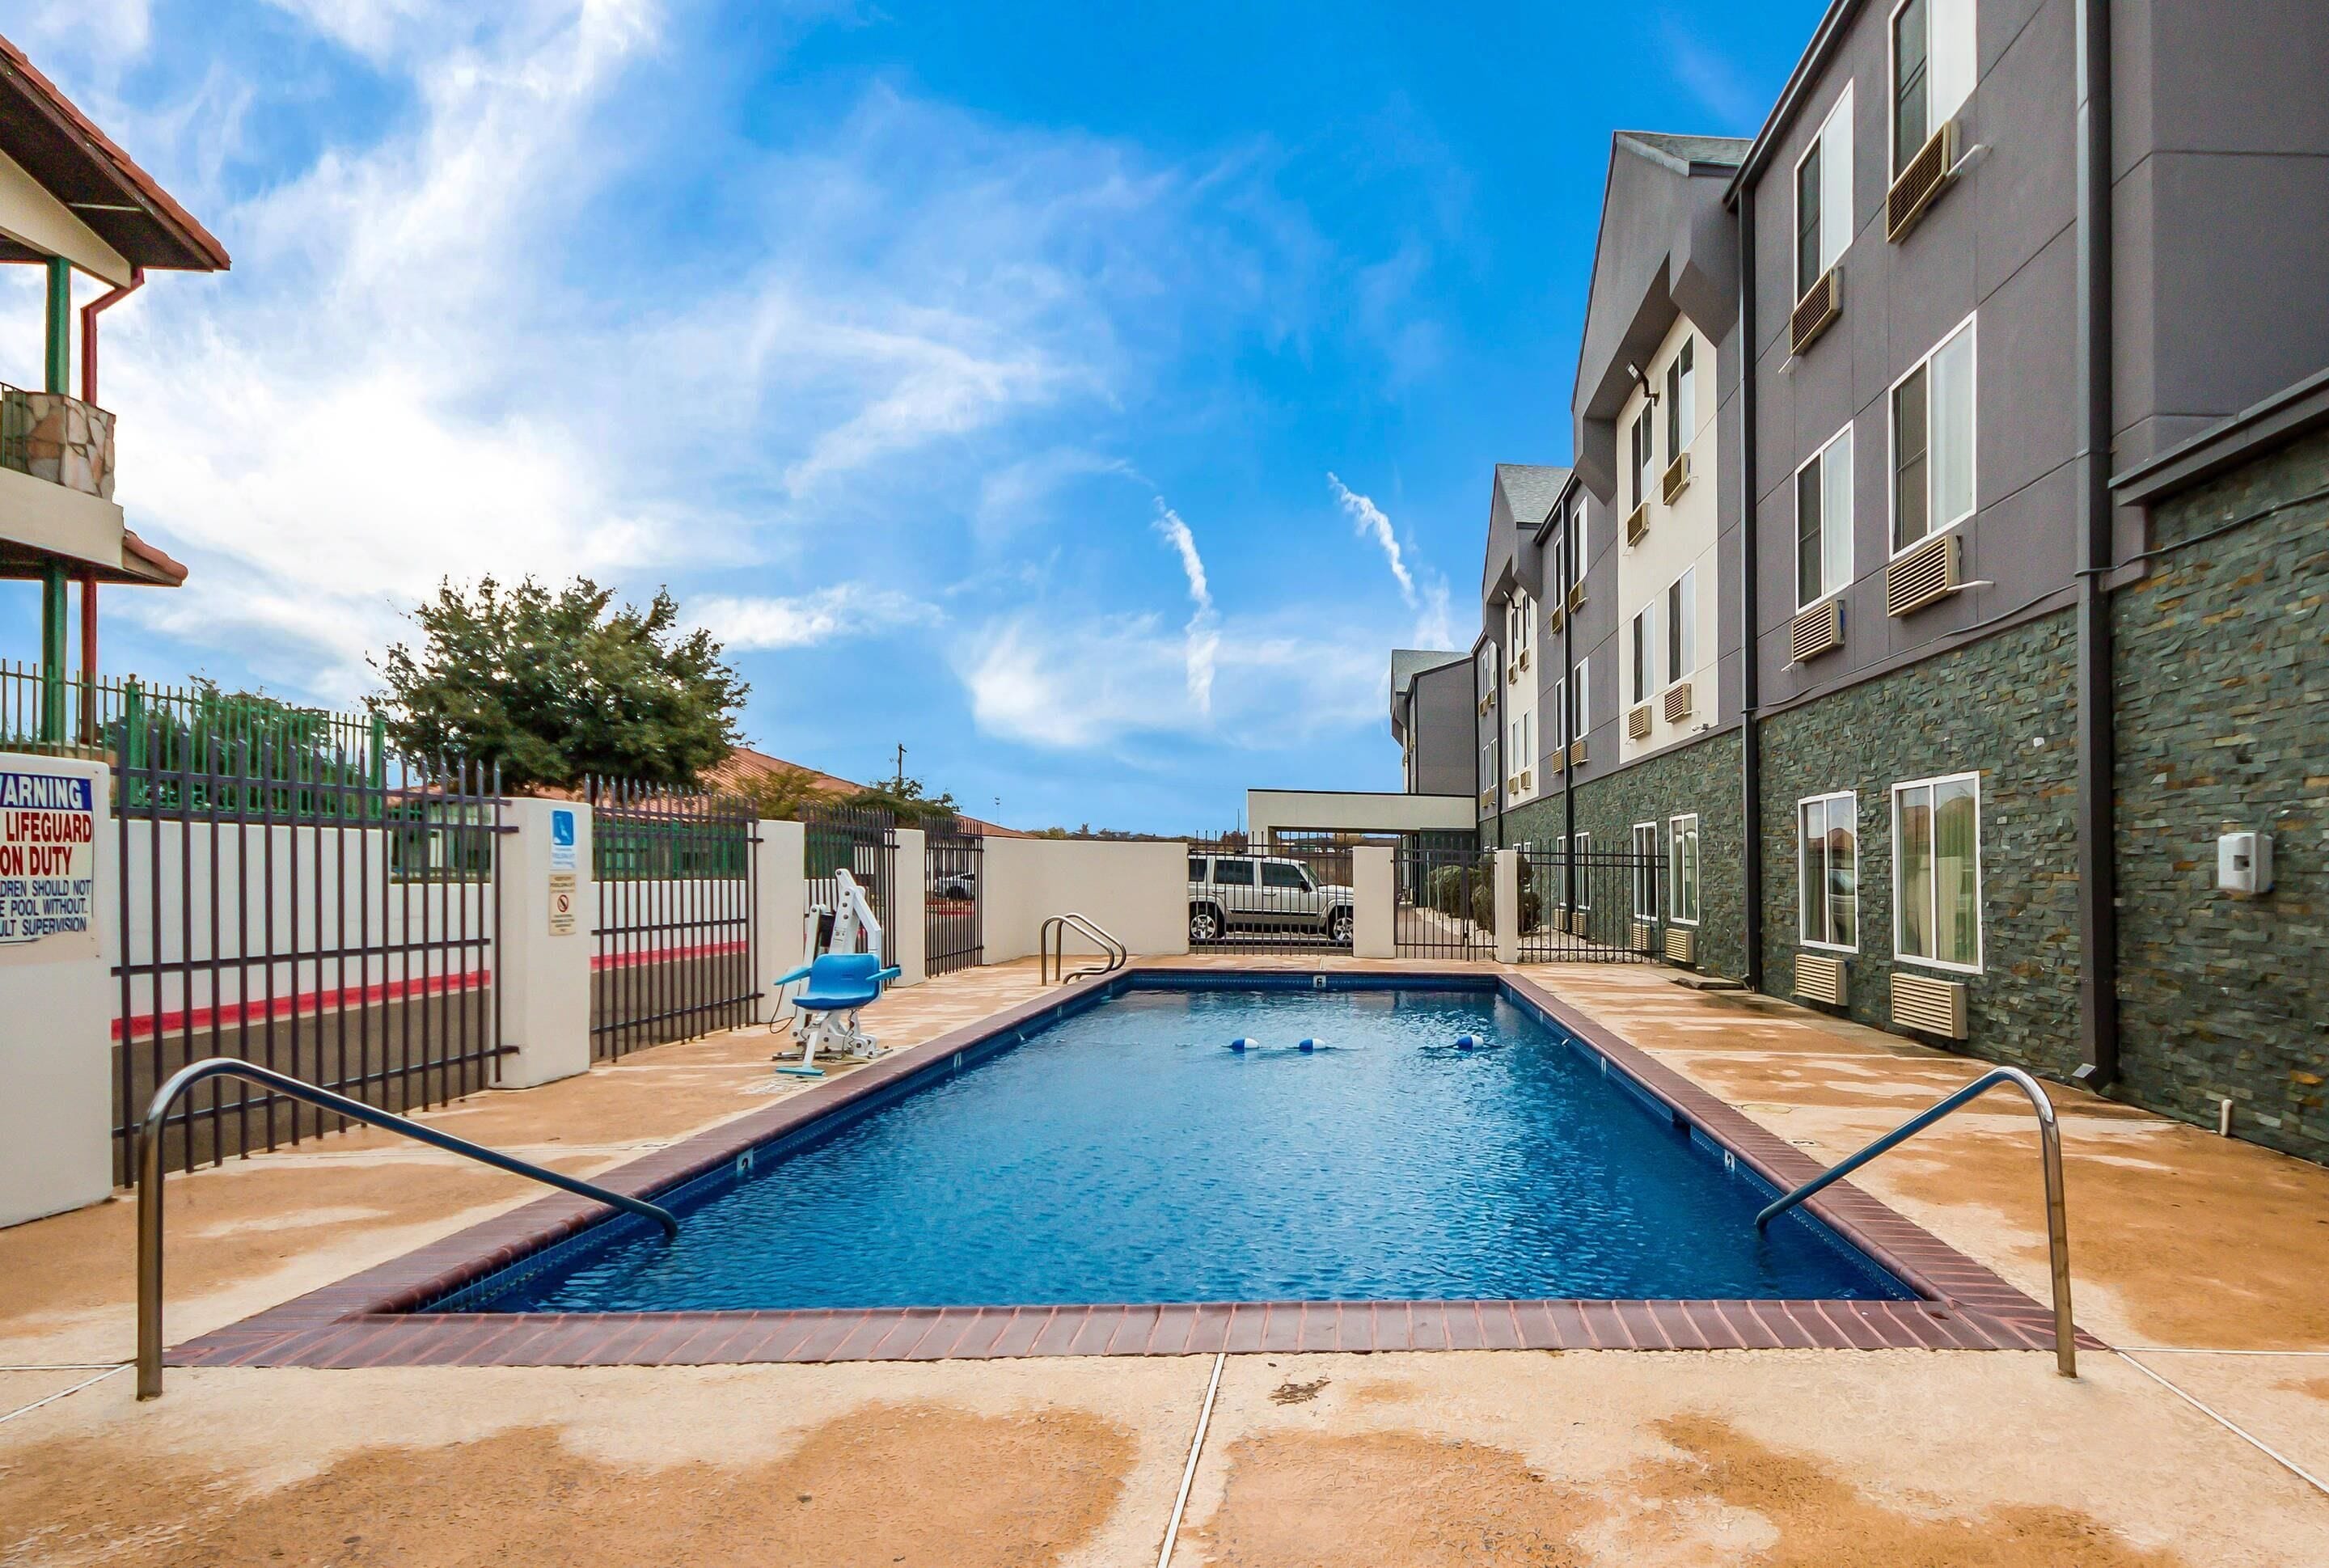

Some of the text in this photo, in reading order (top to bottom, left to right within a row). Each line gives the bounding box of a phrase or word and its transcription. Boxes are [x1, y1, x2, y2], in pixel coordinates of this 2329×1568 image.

[6, 811, 92, 843] LIFEGUARD
[0, 845, 73, 877] ON DUTY
[32, 879, 69, 897] SHOULD
[74, 879, 91, 895] NOT
[11, 899, 39, 916] POOL
[43, 898, 86, 915] WITHOUT
[22, 916, 87, 936] SUPERVISION
